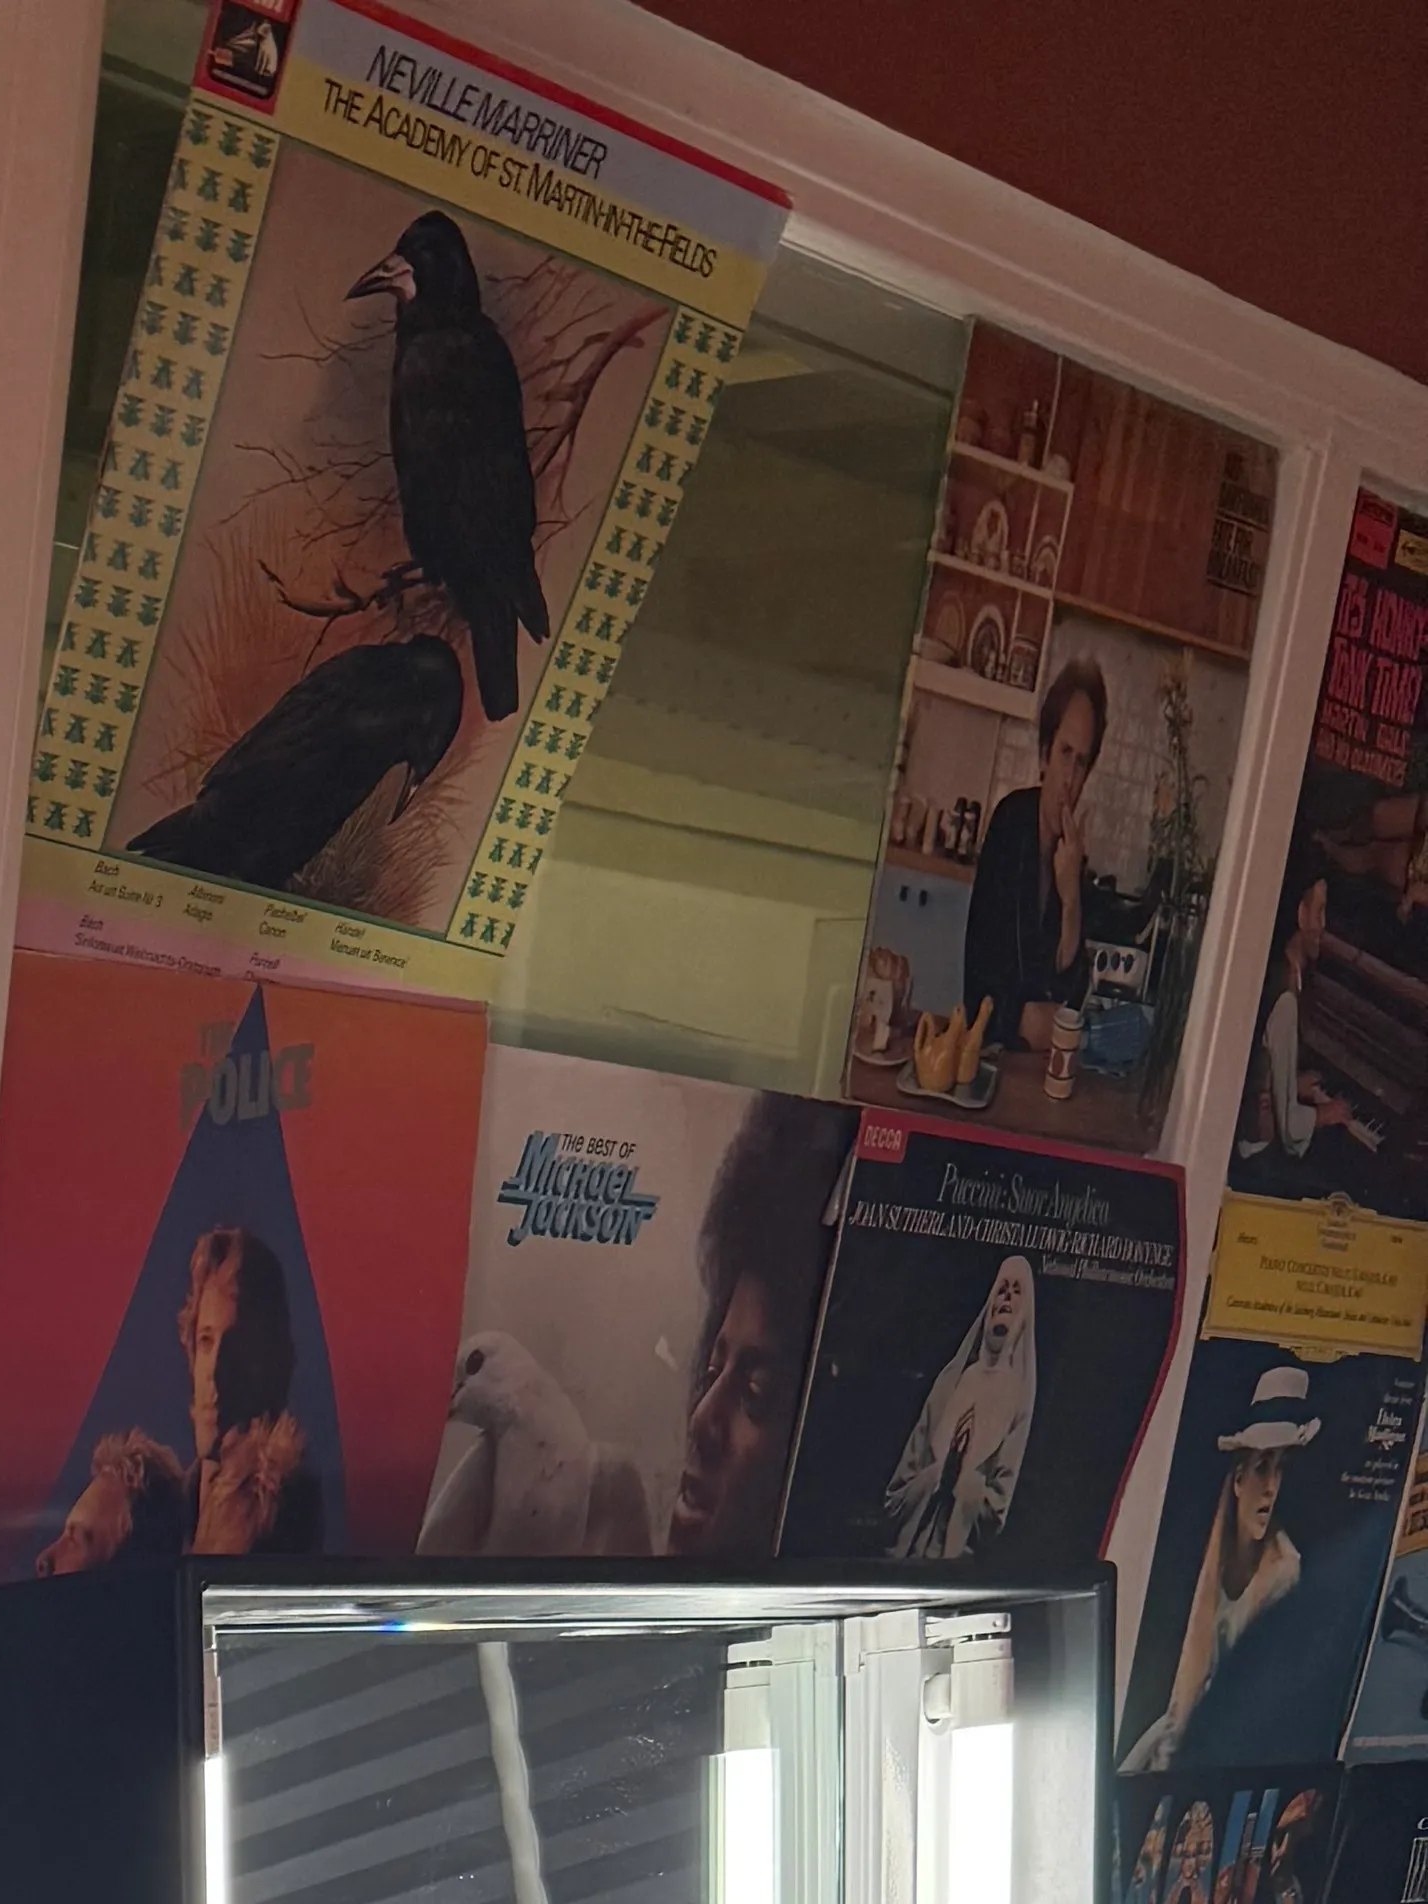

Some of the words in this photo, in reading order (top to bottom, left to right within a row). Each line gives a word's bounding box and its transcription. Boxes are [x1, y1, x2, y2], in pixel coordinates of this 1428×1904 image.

[324, 78, 366, 125] THE
[363, 94, 473, 167] ACADEMY
[471, 145, 500, 178] OF
[365, 45, 479, 122] NEVILLE
[472, 92, 608, 179] MARRINER
[179, 1042, 316, 1133] POLICE
[618, 1141, 637, 1159] OF
[863, 1124, 903, 1151] DECCA
[848, 1199, 886, 1228] JOAN
[936, 1161, 1008, 1206] Puccini:
[1007, 1171, 1044, 1216] Suor
[1046, 1178, 1112, 1228] Angelica
